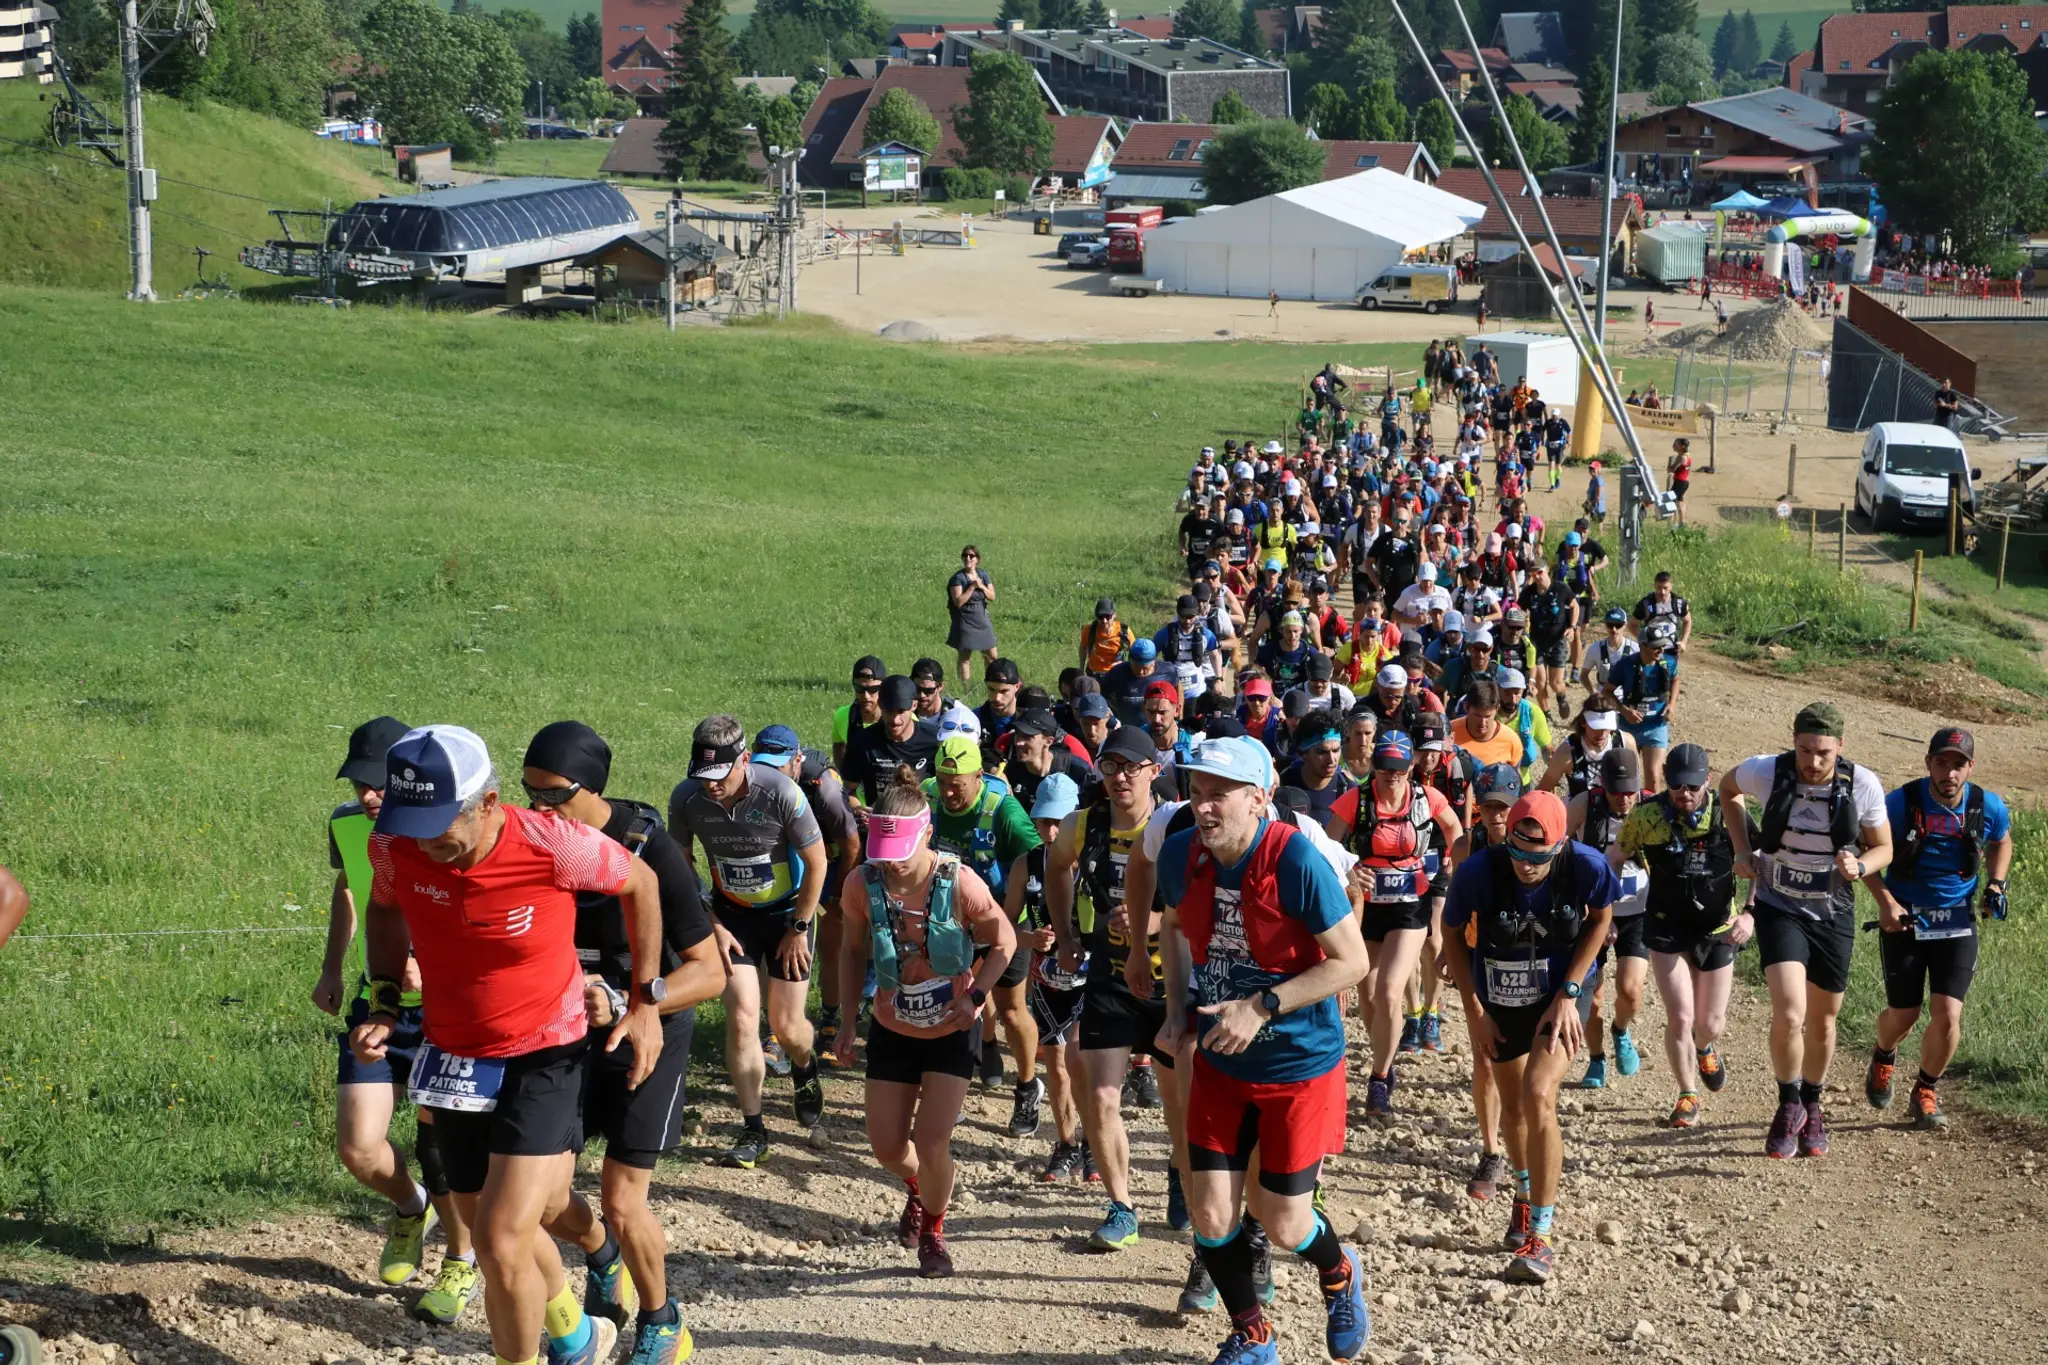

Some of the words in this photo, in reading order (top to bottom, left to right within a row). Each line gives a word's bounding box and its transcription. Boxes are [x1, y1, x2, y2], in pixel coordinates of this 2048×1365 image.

[1641, 410, 1682, 420] RALENTIR
[1652, 419, 1675, 427] SLOW
[391, 774, 435, 792] Sherpa
[732, 867, 754, 878] 713
[1788, 870, 1813, 884] 790
[1929, 909, 1951, 923] 799
[1501, 972, 1528, 987] 628
[1495, 986, 1538, 995] ALEXANDR
[904, 992, 934, 1009] 775
[901, 1002, 943, 1017] CLEMENCE
[439, 1053, 476, 1078] 783
[428, 1076, 478, 1093] PATRICE
